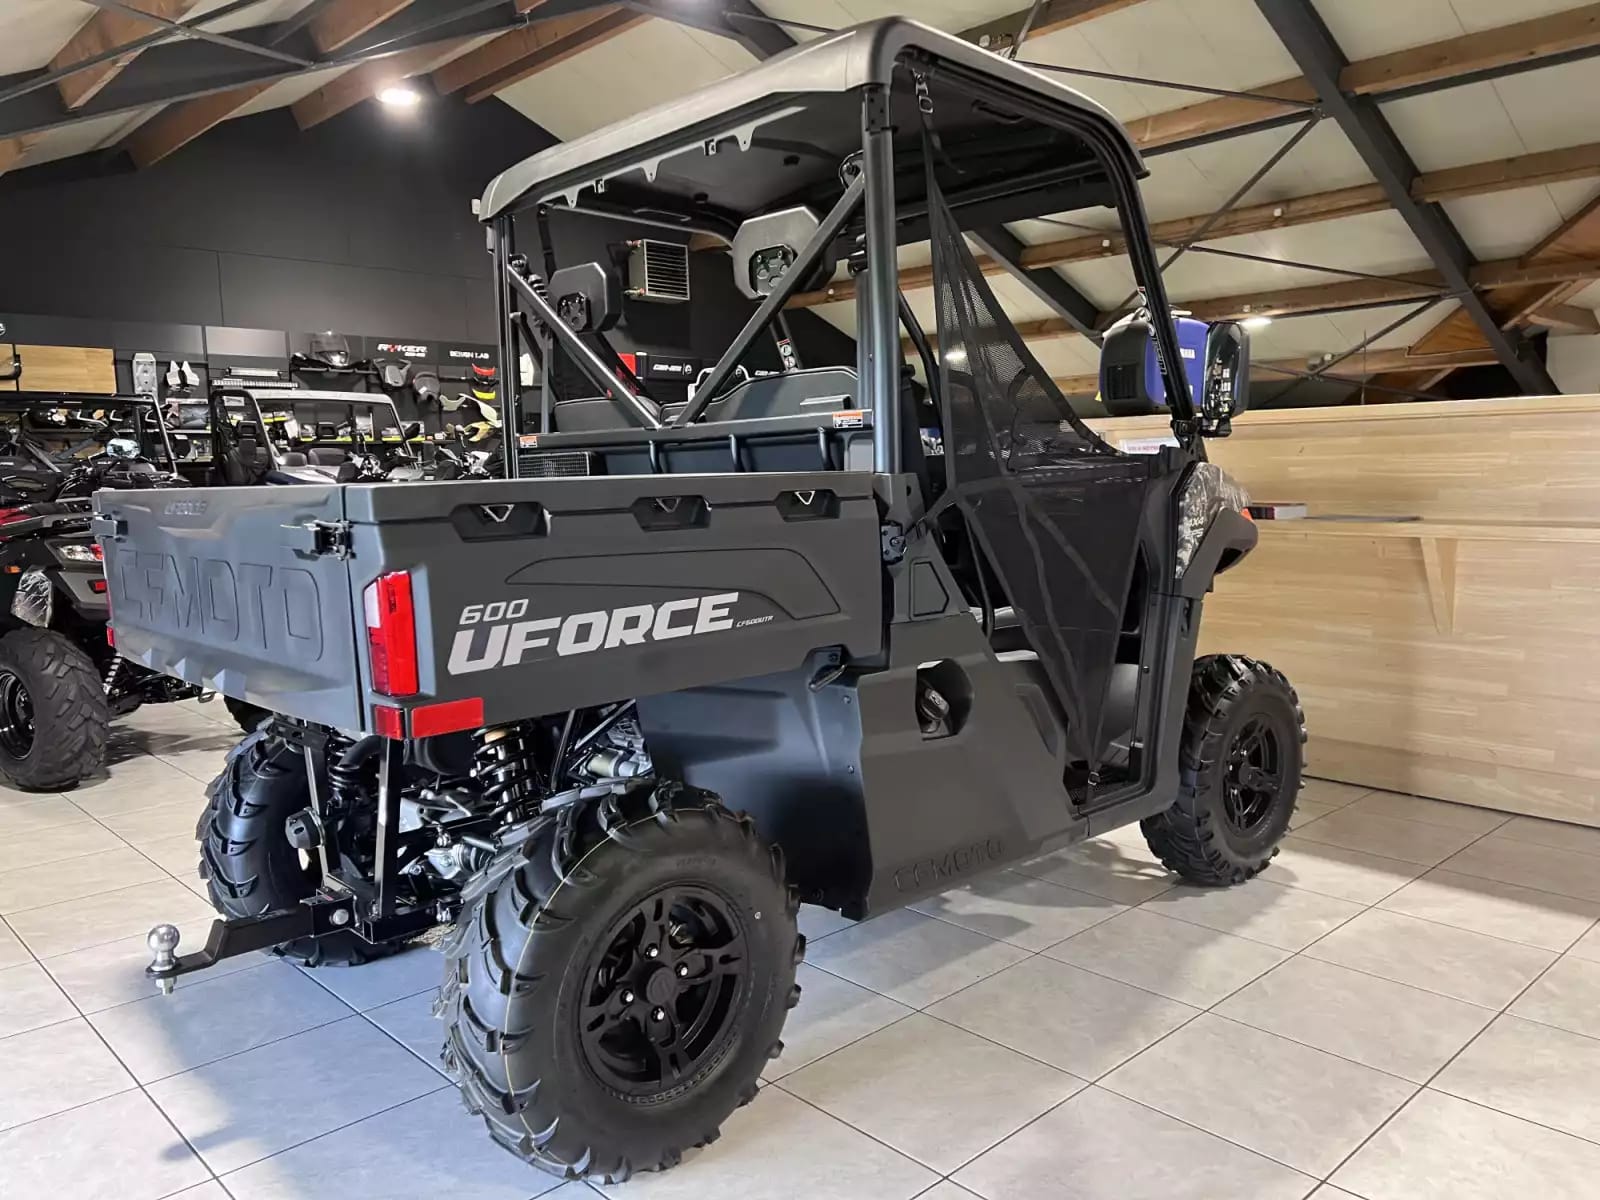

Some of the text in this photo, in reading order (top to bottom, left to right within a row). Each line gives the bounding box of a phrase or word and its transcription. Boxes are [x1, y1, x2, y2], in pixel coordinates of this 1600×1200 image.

[377, 343, 428, 353] RYKER
[118, 548, 324, 662] CFMOTO
[458, 598, 530, 625] 600
[447, 591, 740, 677] UFORCE
